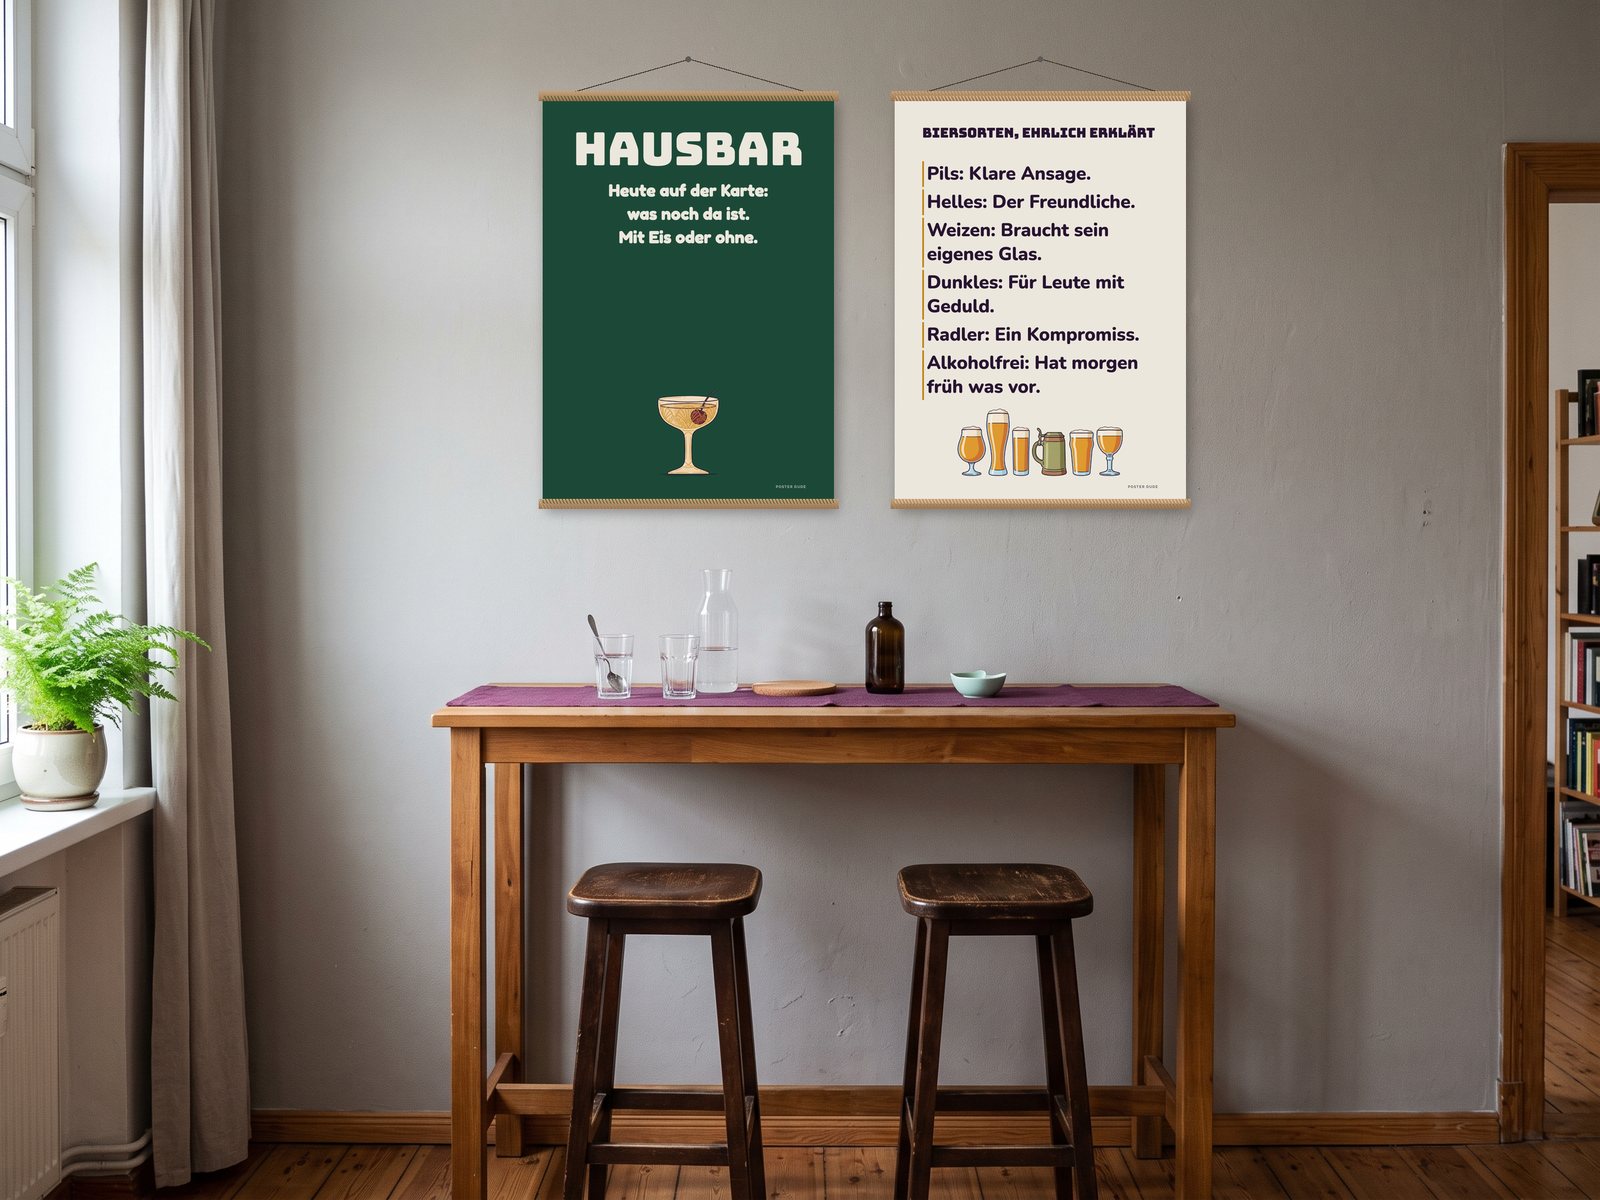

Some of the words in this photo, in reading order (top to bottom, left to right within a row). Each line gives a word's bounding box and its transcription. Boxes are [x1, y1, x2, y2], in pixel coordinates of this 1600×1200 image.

[922, 126, 1020, 140] BIERSORTEN,
[1022, 127, 1087, 139] EHRLICH
[1089, 124, 1156, 139] ERKLÄRT
[575, 131, 803, 167] HAUSBAR
[927, 165, 964, 181] Pils:
[969, 165, 1017, 181] Klare
[1020, 165, 1091, 184] Ansage.
[608, 183, 657, 198] Heute
[659, 182, 687, 198] auf
[689, 183, 718, 198] der
[720, 183, 769, 198] Karte:
[927, 194, 988, 209] Helles:
[992, 194, 1025, 209] Der
[1029, 193, 1136, 209] Freundliche.
[626, 210, 658, 221] was
[660, 206, 700, 221] noch
[702, 206, 723, 221] da
[725, 206, 750, 221] ist.
[618, 229, 646, 245] Mit
[648, 229, 672, 245] Eis
[674, 229, 712, 245] oder
[714, 229, 759, 245] ohne.
[926, 222, 996, 238] Weizen:
[1001, 222, 1070, 238] Braucht
[1074, 221, 1109, 238] sein
[926, 245, 994, 265] eigenes
[998, 246, 1042, 262] Glas.
[927, 274, 1003, 290] Dunkles:
[1008, 274, 1038, 290] Für
[1042, 274, 1091, 290] Leute
[1095, 274, 1125, 290] mit
[927, 298, 995, 314] Geduld.
[927, 326, 990, 342] Radler:
[995, 326, 1022, 342] Ein
[1027, 326, 1140, 345] Kompromiss.
[926, 354, 1030, 370] Alkoholfrei:
[1034, 354, 1068, 370] Hat
[1071, 358, 1138, 374] morgen
[926, 378, 963, 394] früh
[968, 382, 1004, 394] was
[1007, 382, 1041, 394] vor.
